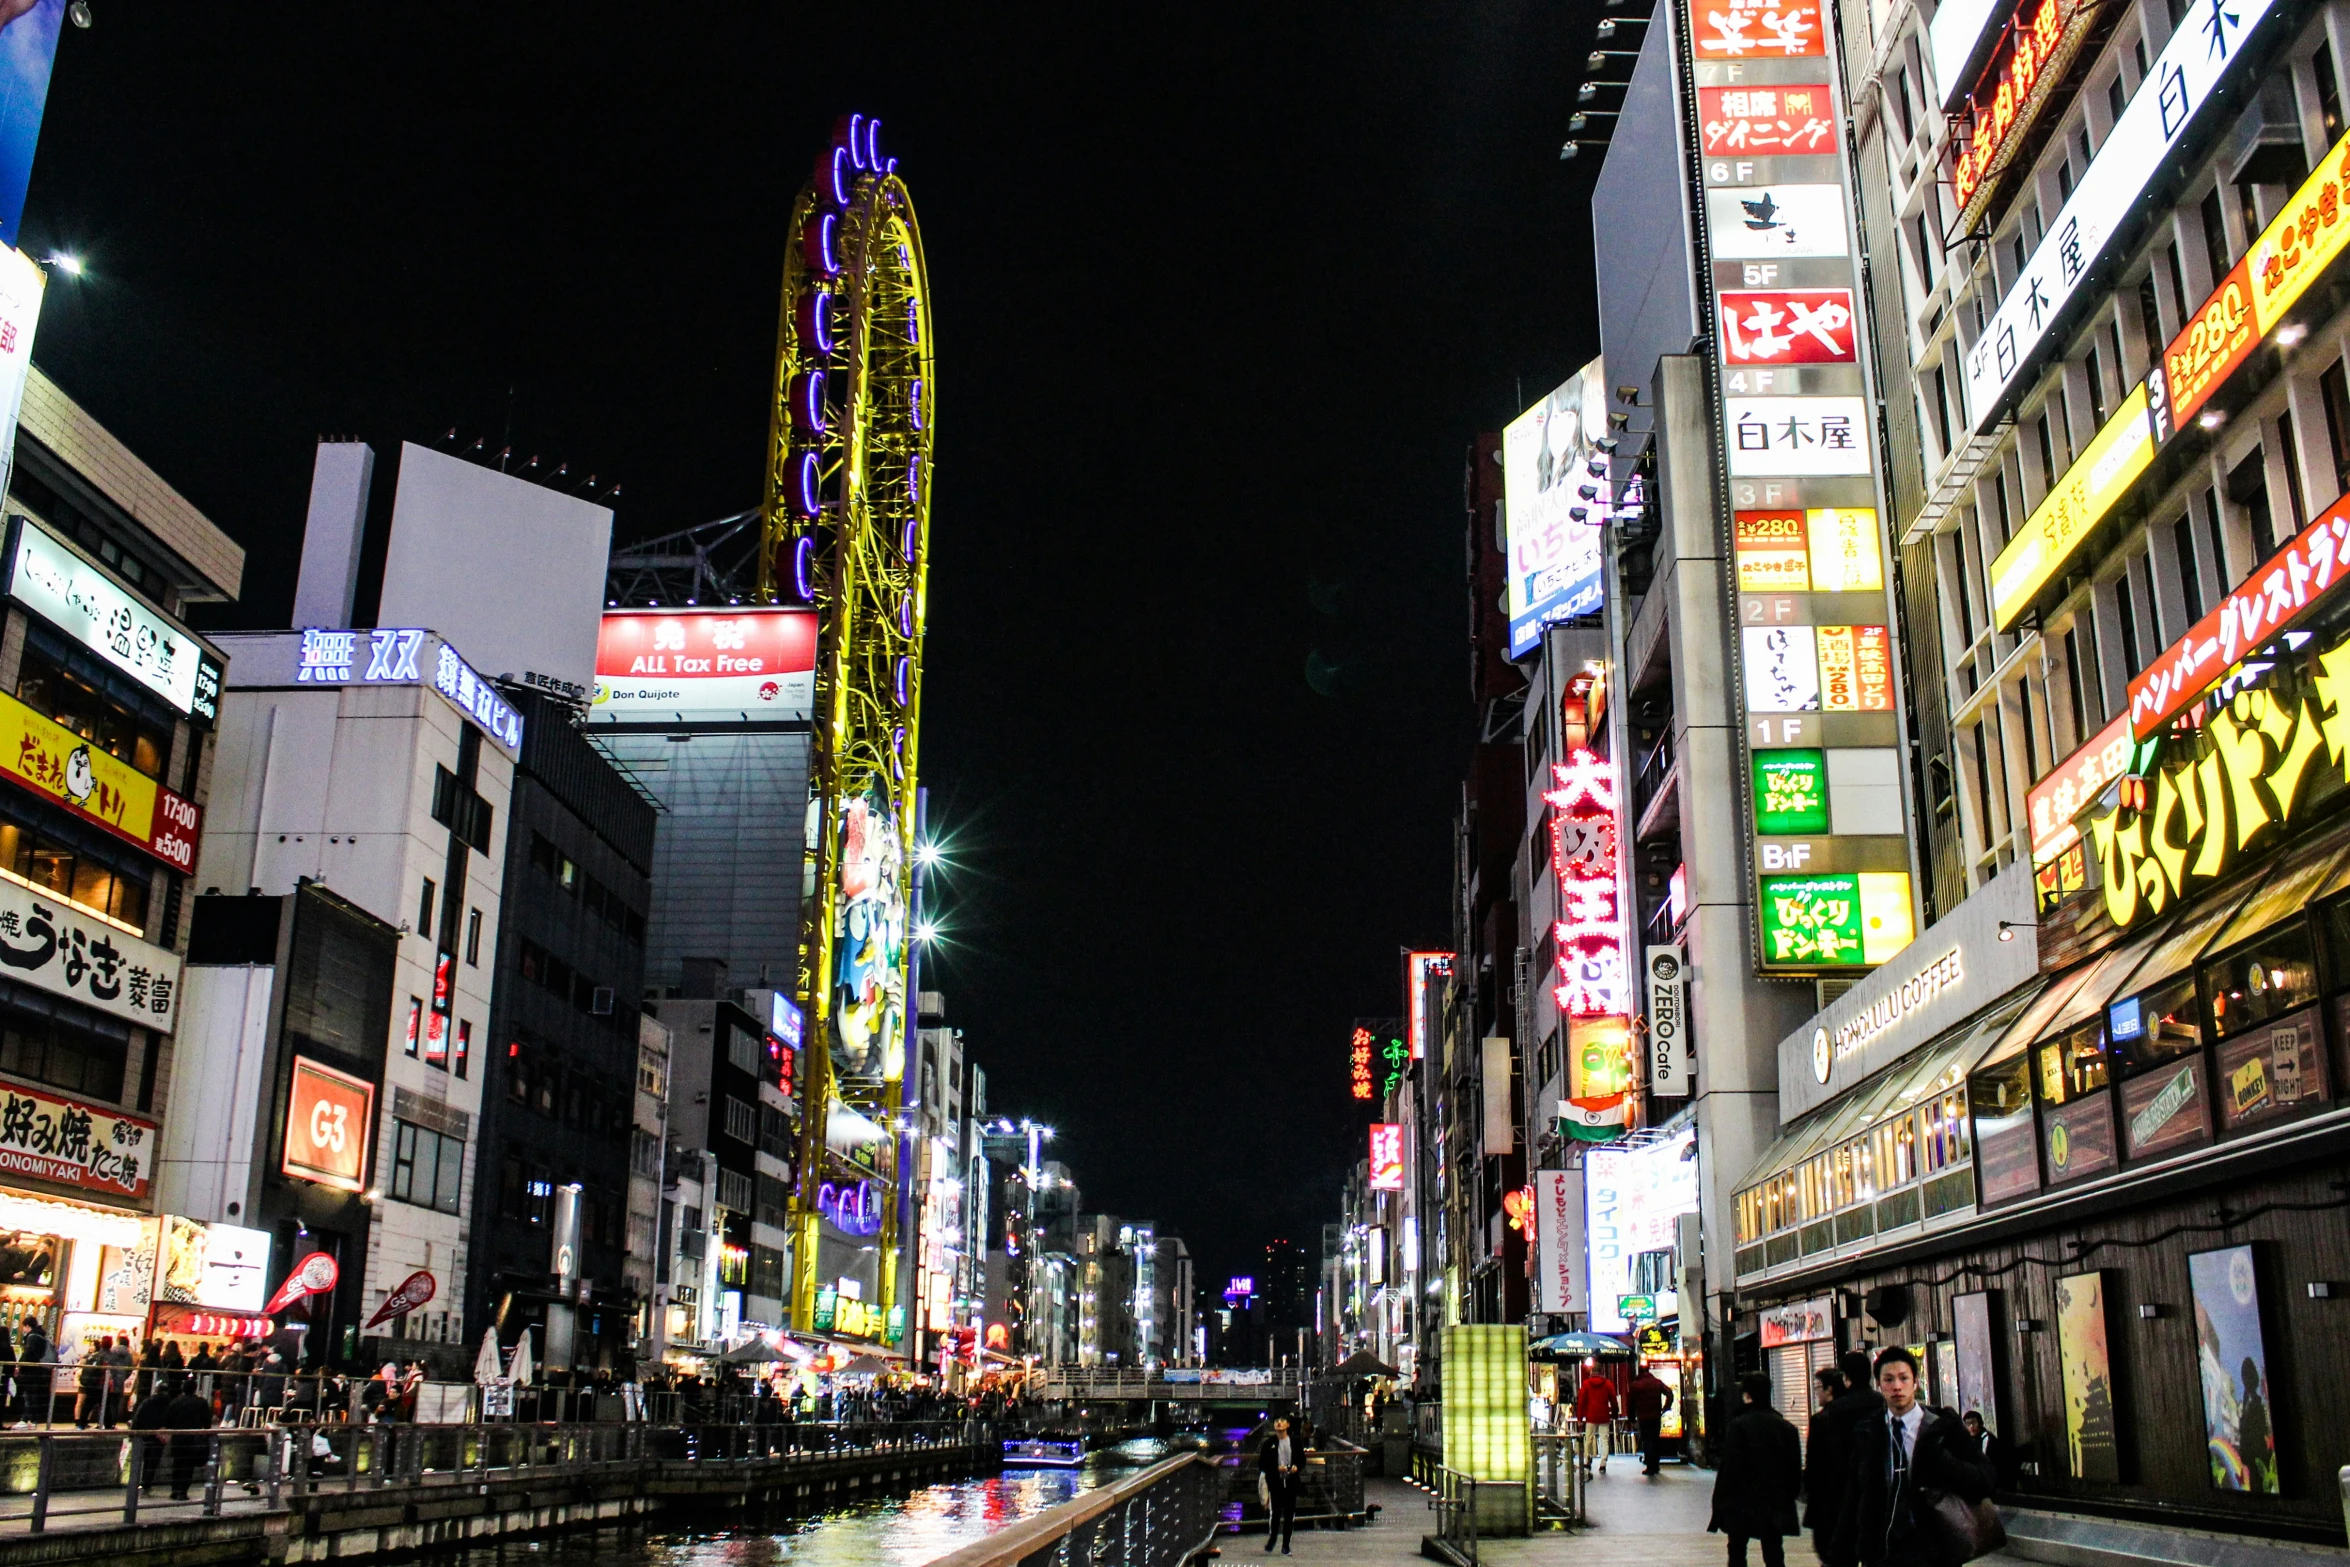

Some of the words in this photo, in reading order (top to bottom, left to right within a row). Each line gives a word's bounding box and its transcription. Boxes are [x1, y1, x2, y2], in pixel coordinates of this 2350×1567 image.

[1701, 64, 1743, 82] 7F
[1721, 91, 1777, 117] 相席
[1704, 118, 1832, 150] ダイニング
[1710, 162, 1753, 182] 6F
[1744, 264, 1778, 285] 5F
[1996, 215, 2086, 384] 白木屋
[1723, 300, 1850, 360] はや
[1728, 371, 1774, 393] 4F
[1737, 411, 1856, 450] 白木屋
[1739, 483, 1782, 505] 3F
[1747, 600, 1791, 621] 2F
[106, 607, 176, 686] 温野菜
[1863, 627, 1883, 636] 2F
[630, 655, 667, 673] ALL
[673, 655, 711, 673] Tax
[716, 654, 763, 672] Free
[1857, 636, 1886, 709] 豊後高田どり
[197, 673, 217, 698] 17:00
[612, 689, 635, 699] Don
[638, 689, 680, 700] Quijote
[1829, 672, 1849, 705] 280
[1756, 719, 1802, 743] 1F
[18, 732, 65, 790] だまれ
[1765, 770, 1813, 793] びっくり
[100, 781, 126, 828] トリ
[163, 793, 196, 830] 17:00
[1764, 792, 1818, 812] ドンキー
[1762, 843, 1811, 869] B1F
[1542, 748, 1621, 1016] 大阪王将
[1774, 892, 1850, 930] びっくり
[0, 902, 126, 1000] うなぎ
[128, 965, 173, 1014] 菱富
[1772, 928, 1858, 960] ドンキー
[1654, 984, 1675, 1039] ZERO
[1834, 991, 1899, 1058] HONOLULU
[1901, 948, 1961, 1011] COFFEE
[2273, 1034, 2295, 1051] KEEP
[1352, 1027, 1372, 1099] お好み焼
[2275, 1077, 2301, 1095] RIGHT
[310, 1099, 348, 1153] G3
[90, 1139, 140, 1190] たこ焼
[1596, 1188, 1620, 1259] タイコク
[1554, 1173, 1572, 1308] よしもとエンタメショップ
[390, 1292, 407, 1308] G3
